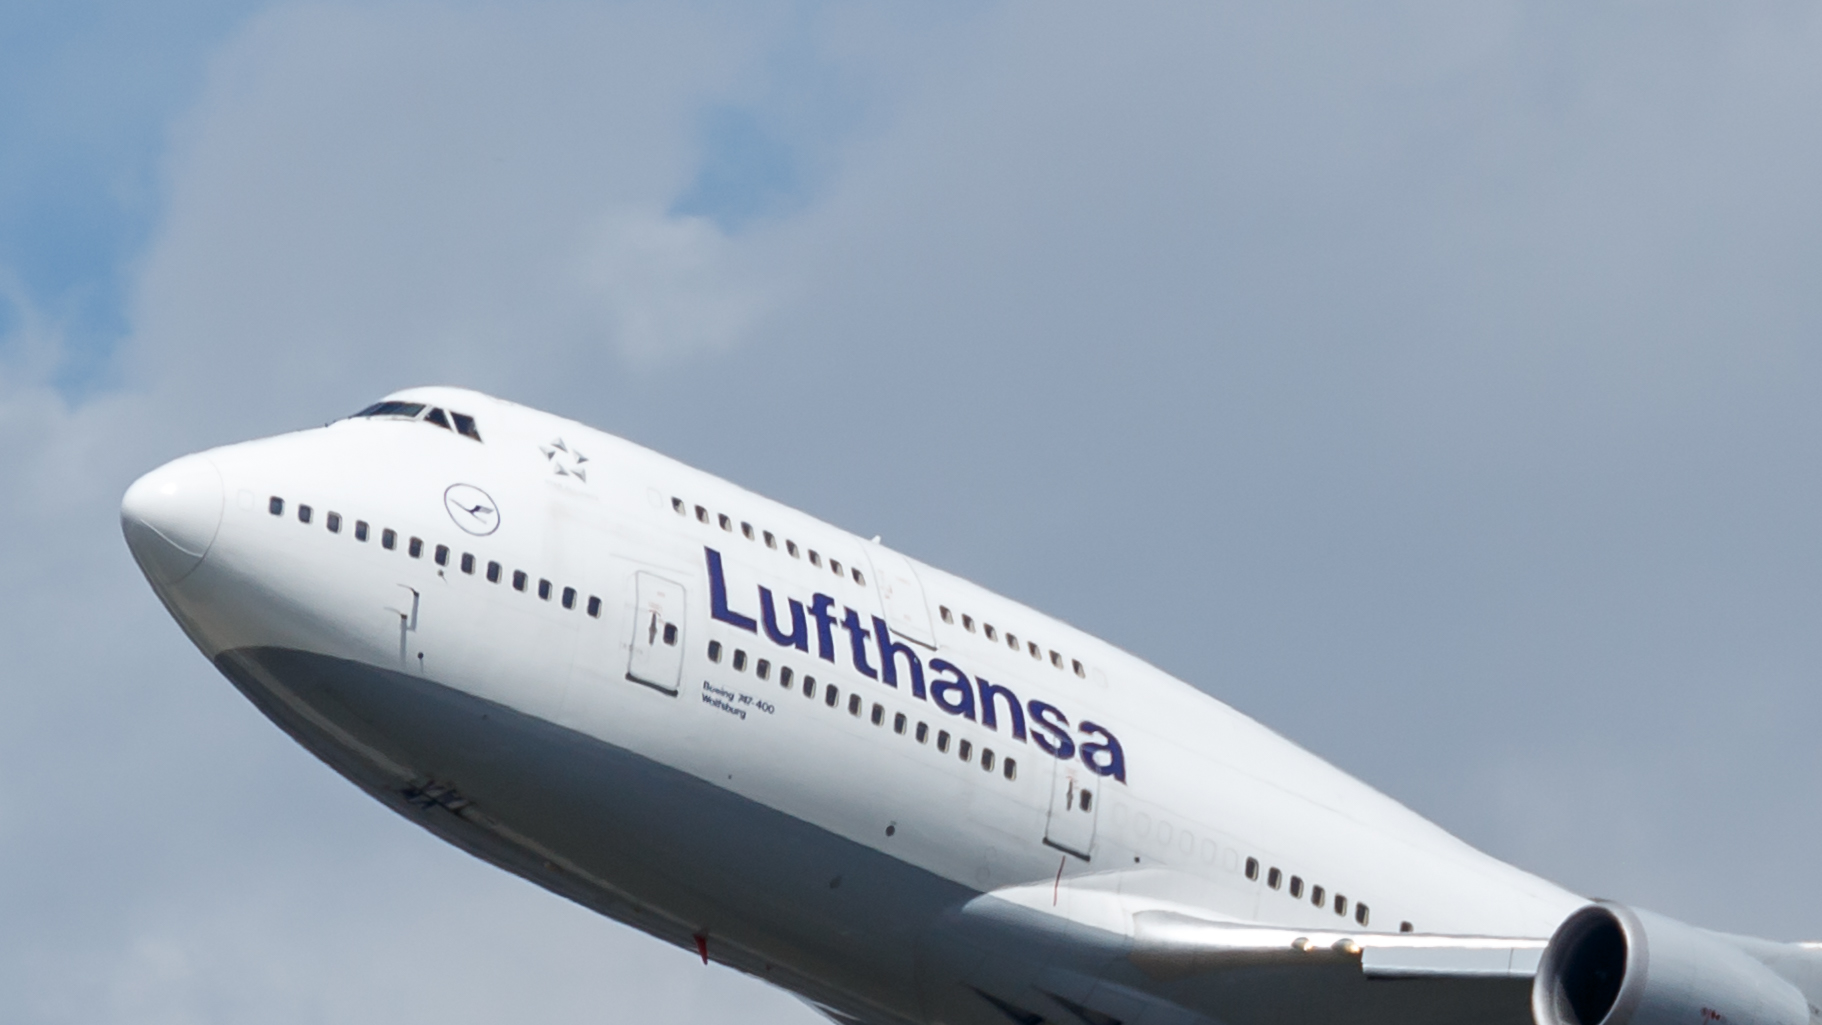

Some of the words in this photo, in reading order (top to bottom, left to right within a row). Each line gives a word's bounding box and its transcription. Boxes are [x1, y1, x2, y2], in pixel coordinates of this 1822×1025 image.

[704, 546, 1127, 784] Lufthansa
[703, 680, 735, 701] Boeing
[702, 693, 746, 720] Wolfsburg
